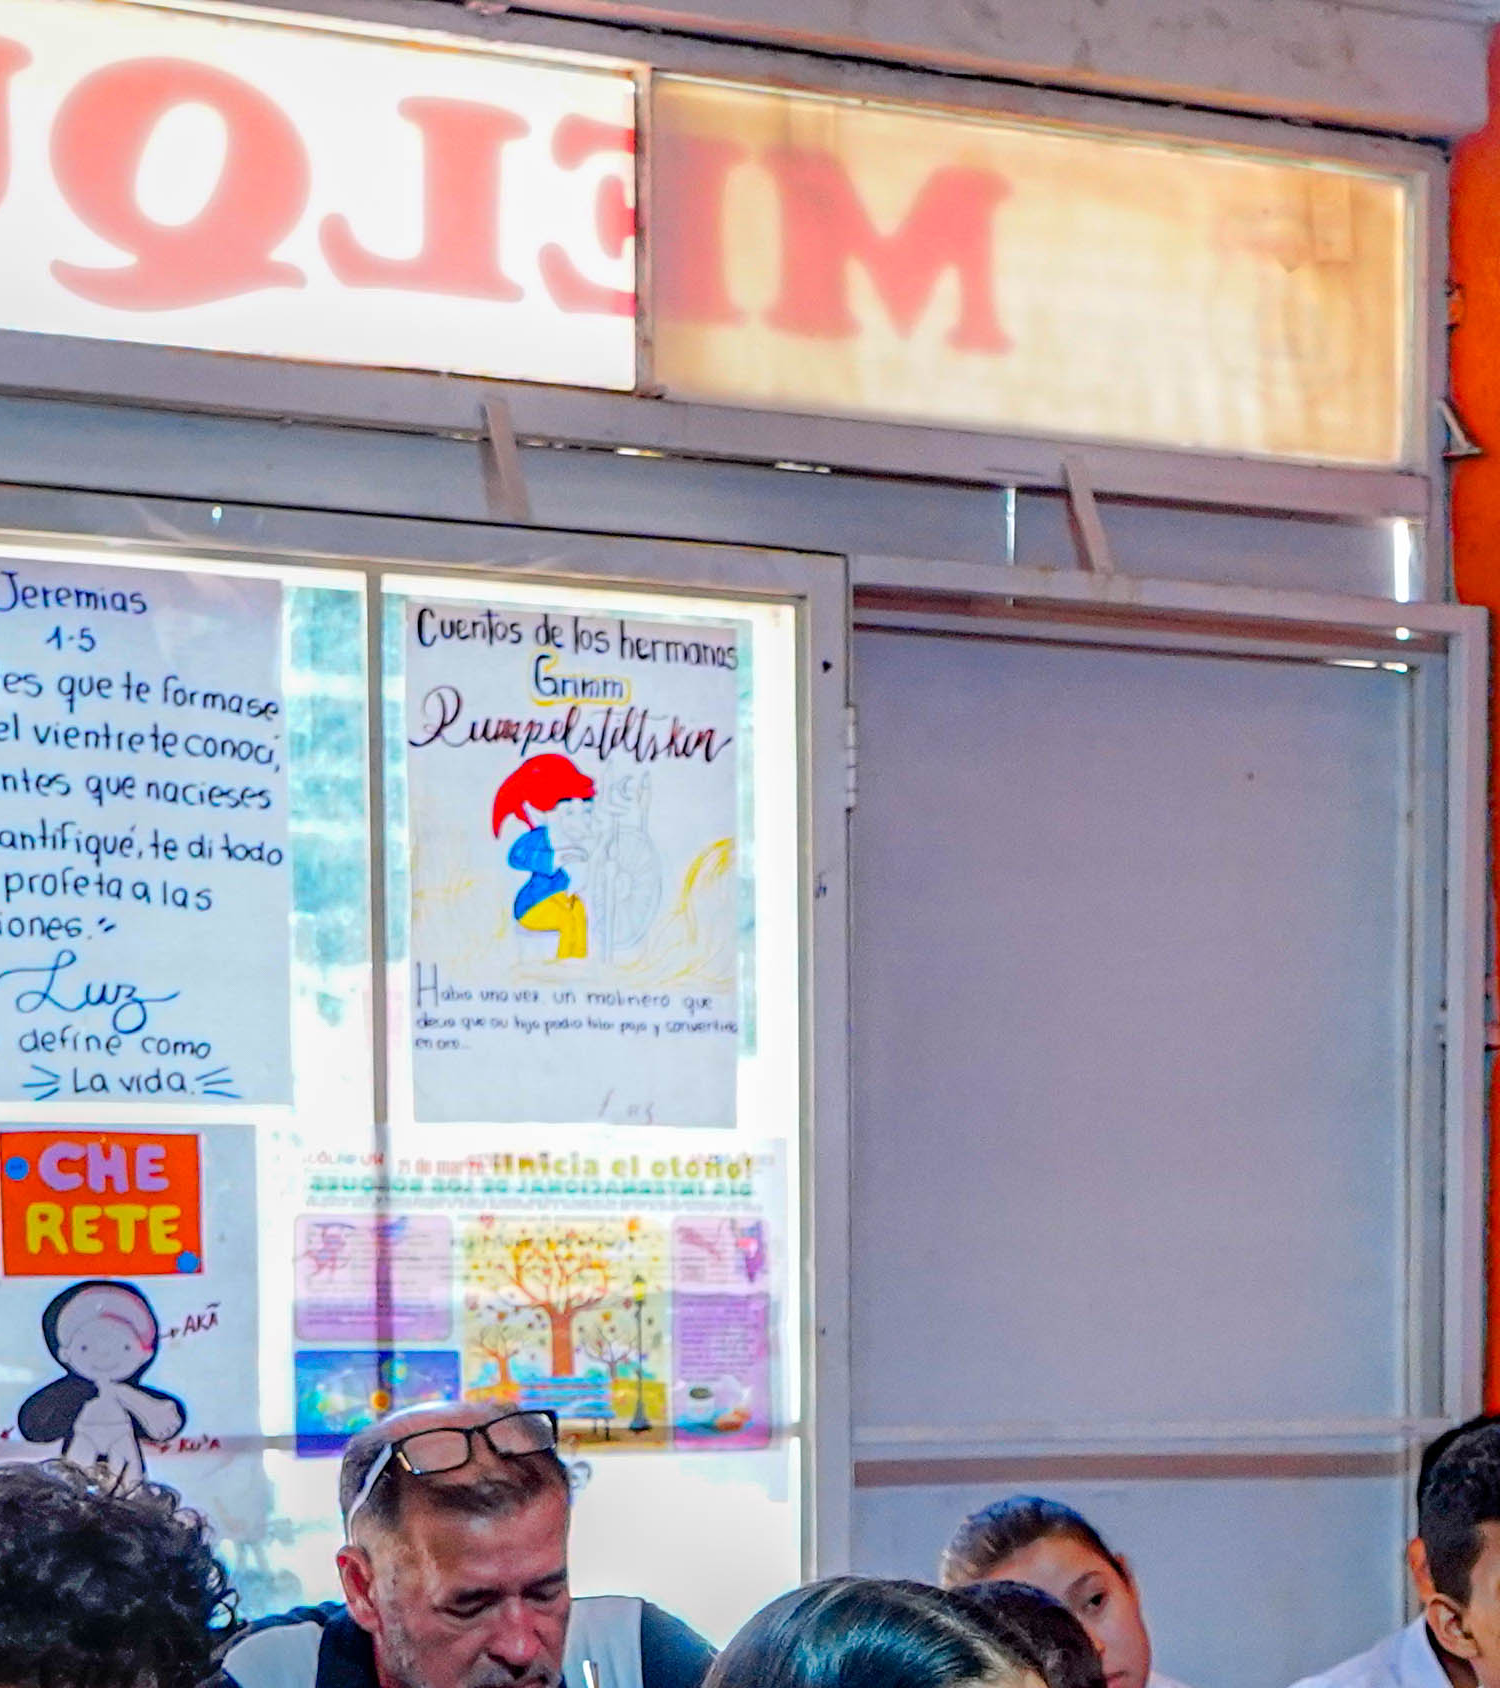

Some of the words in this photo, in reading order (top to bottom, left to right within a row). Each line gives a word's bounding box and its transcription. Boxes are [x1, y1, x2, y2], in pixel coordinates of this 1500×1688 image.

[417, 607, 522, 647] Cuentos
[535, 613, 564, 648] de
[573, 615, 611, 654] los
[57, 675, 113, 713] que
[122, 673, 151, 703] te
[161, 675, 280, 721] formase
[86, 777, 138, 807] que
[145, 780, 271, 811] nacieses
[149, 830, 179, 861] te
[188, 828, 215, 860] di
[220, 832, 284, 868] todo
[3, 873, 125, 904] profeta
[131, 882, 151, 905] a
[160, 880, 213, 912] las
[18, 1027, 123, 1058] define
[140, 1036, 212, 1061] como
[72, 1069, 111, 1094] La
[38, 1141, 170, 1193] CHE
[26, 1201, 182, 1255] RETE
